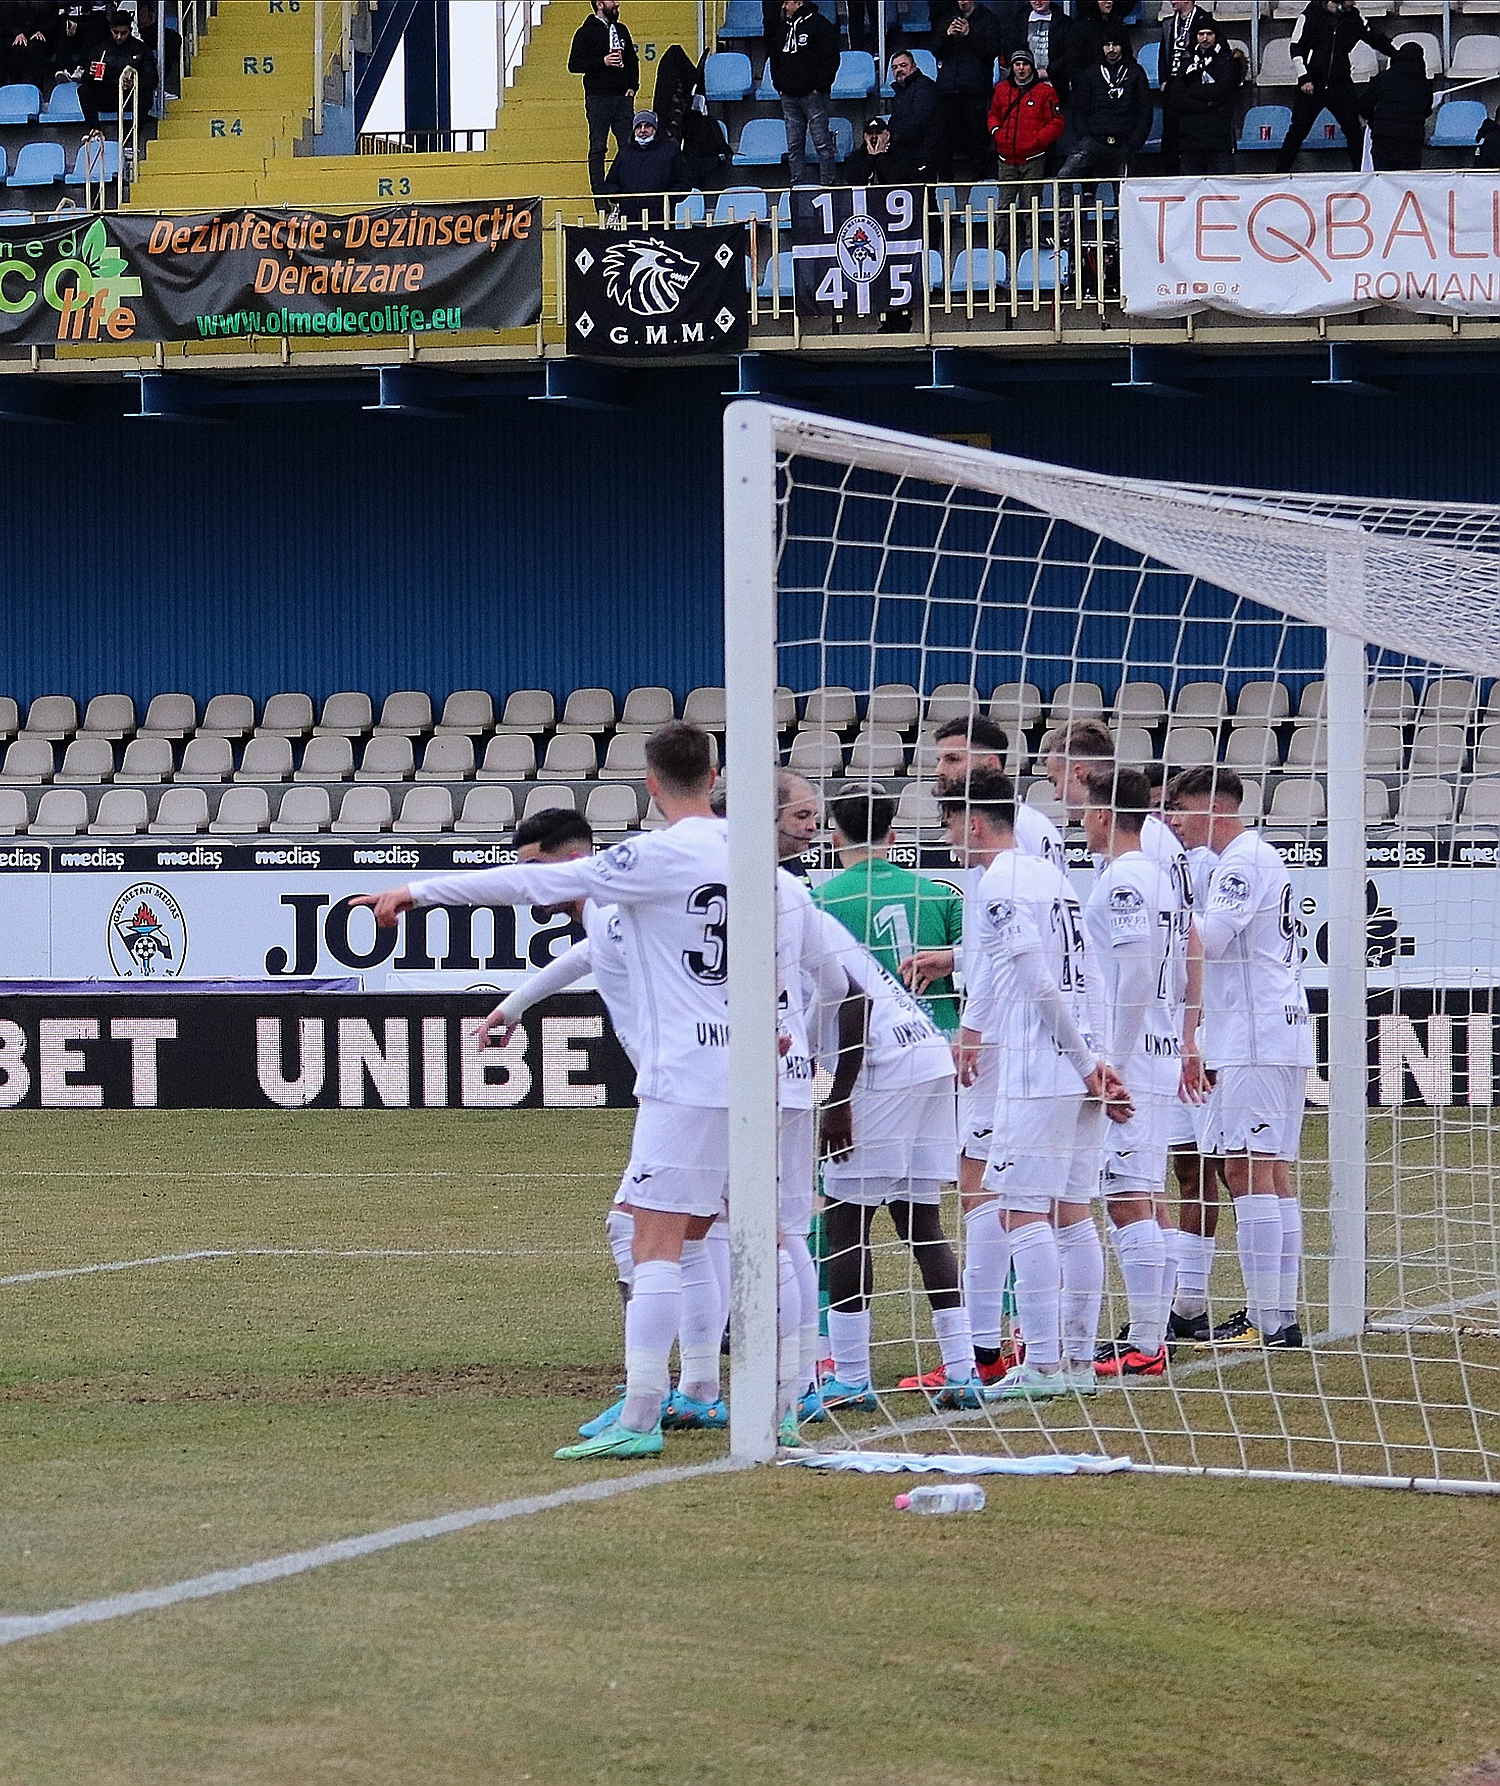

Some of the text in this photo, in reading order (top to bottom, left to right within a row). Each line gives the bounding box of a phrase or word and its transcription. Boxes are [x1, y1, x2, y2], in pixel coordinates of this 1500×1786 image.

[811, 189, 913, 234] 1 9
[148, 205, 532, 261] Dezinfecție Dezinsecție
[254, 257, 425, 295] Deratizare
[719, 251, 728, 261] 9
[815, 263, 913, 309] 4 5
[1353, 271, 1500, 302] ROMAN
[57, 287, 136, 340] life
[196, 305, 463, 336] www.olmedecolife.eu
[580, 314, 730, 330] 4 5
[122, 886, 153, 905] METAN
[264, 892, 590, 976] Joma
[254, 1014, 607, 1108] UNIBE
